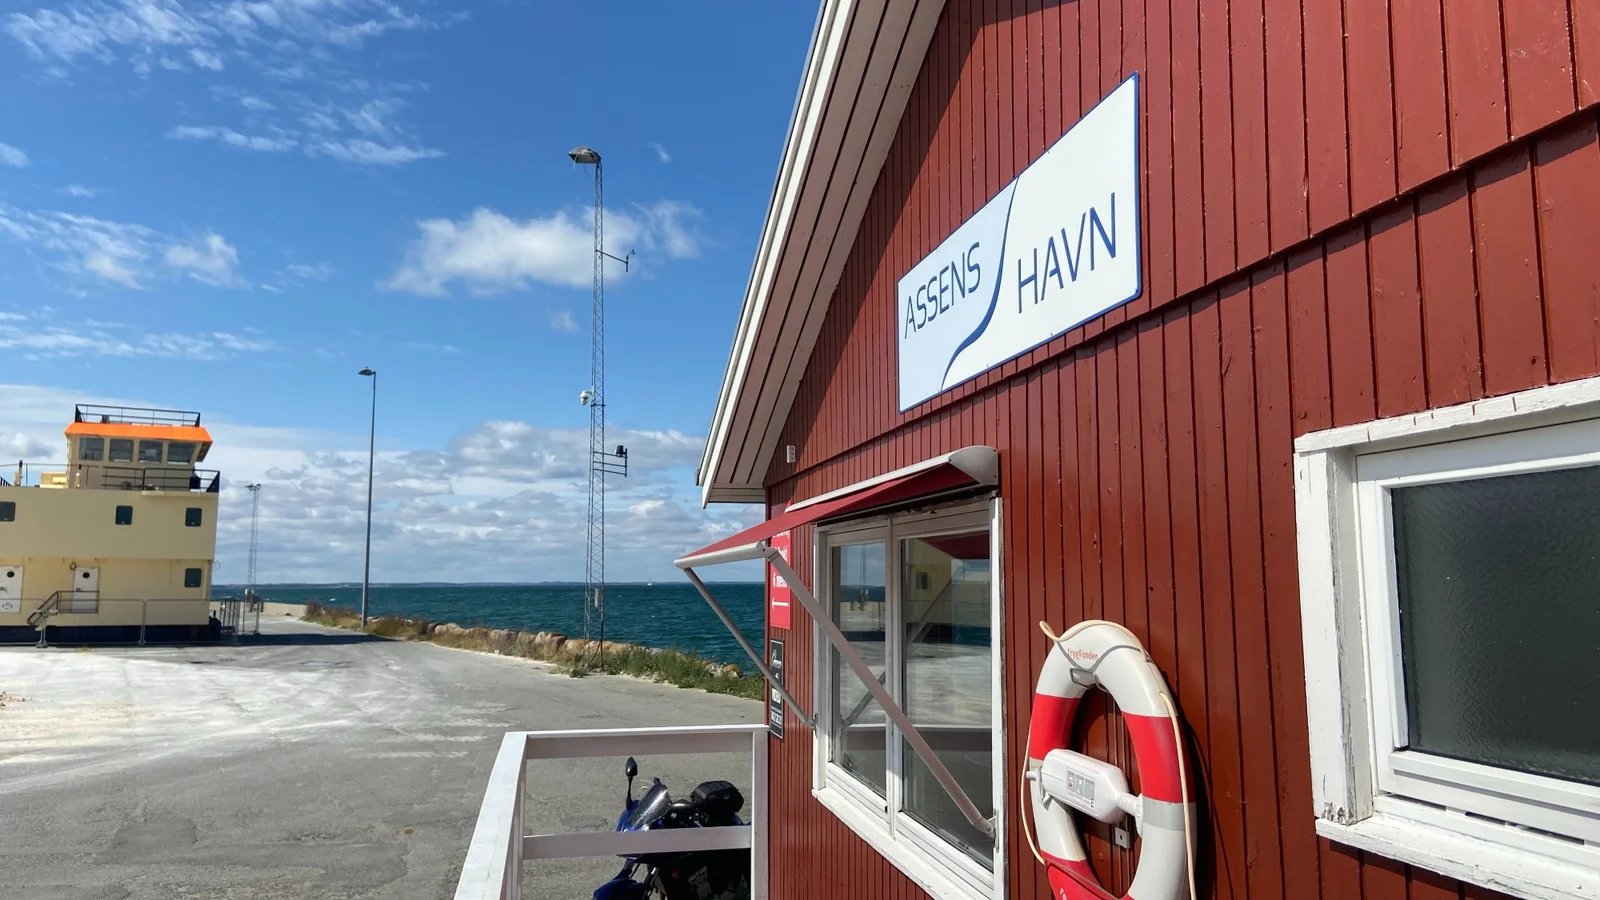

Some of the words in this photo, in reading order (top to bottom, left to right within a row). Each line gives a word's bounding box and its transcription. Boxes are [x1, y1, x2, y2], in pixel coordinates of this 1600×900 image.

[904, 241, 981, 340] ASSENS
[1017, 191, 1116, 314] HAVN
[1067, 648, 1098, 661] TrygFonden
